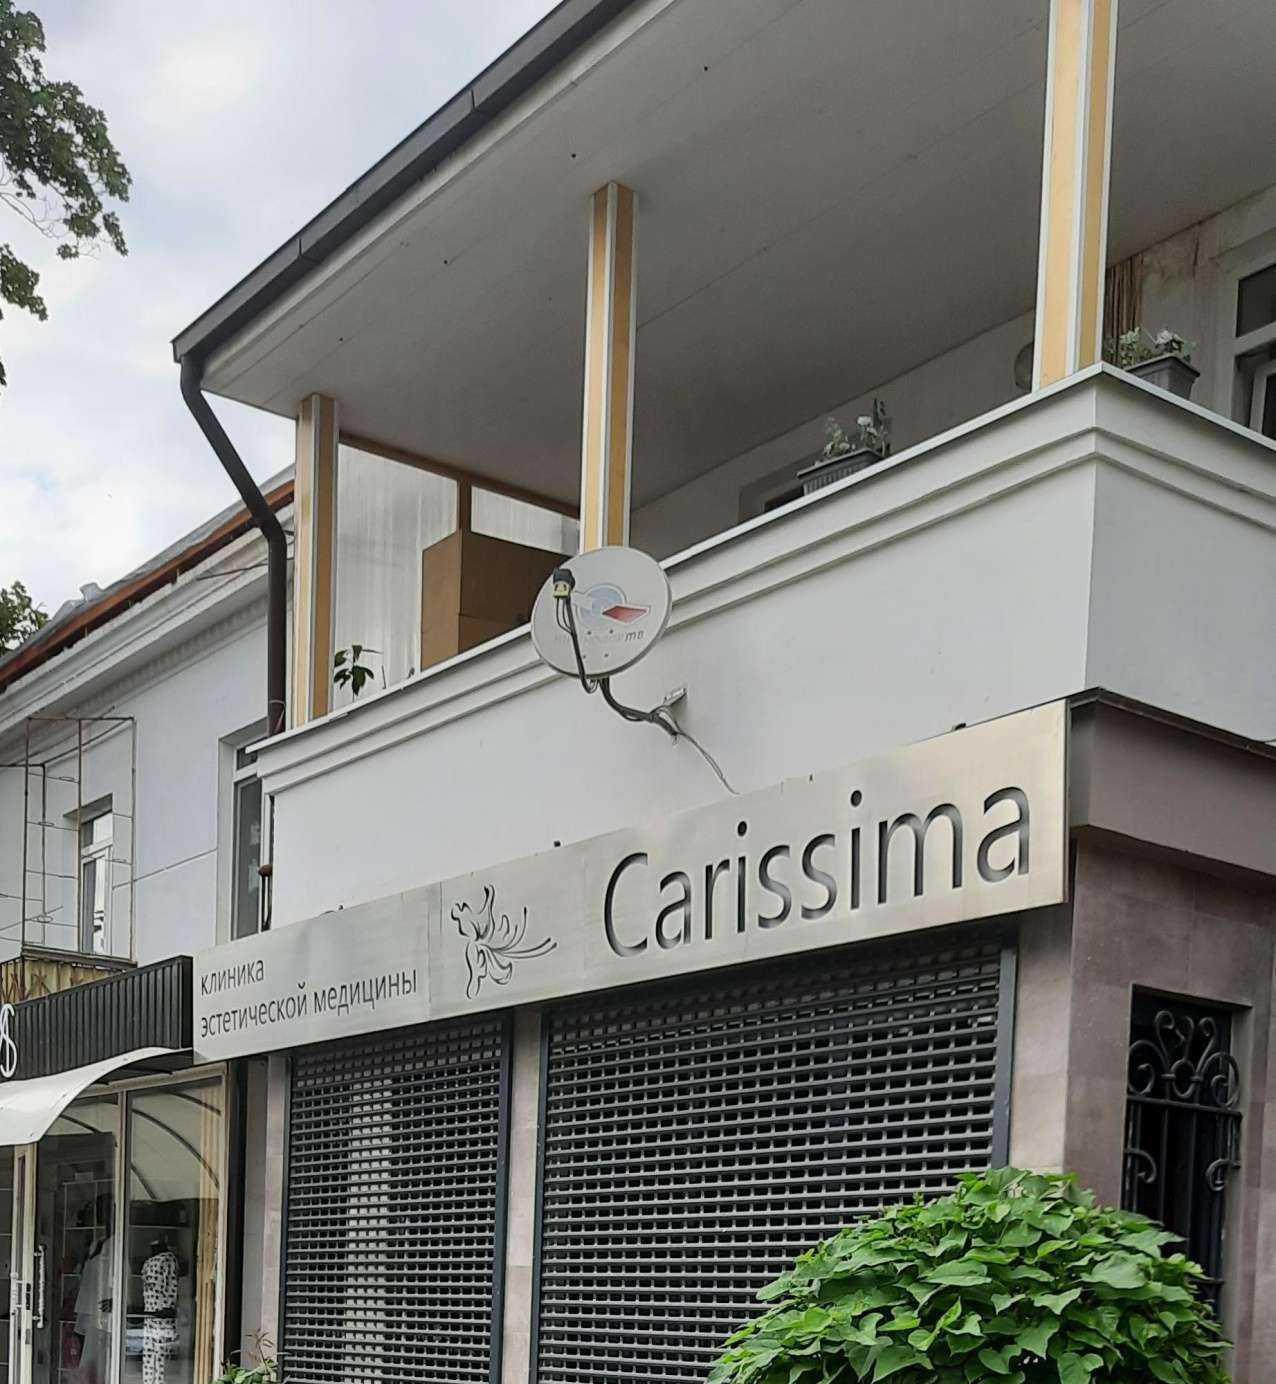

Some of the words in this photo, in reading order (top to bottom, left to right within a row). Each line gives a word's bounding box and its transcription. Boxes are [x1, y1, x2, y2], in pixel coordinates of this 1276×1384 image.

[603, 785, 1031, 959] Carissima
[201, 959, 265, 996] клиника
[201, 981, 308, 1038] эстетической
[313, 969, 417, 1017] медицины
